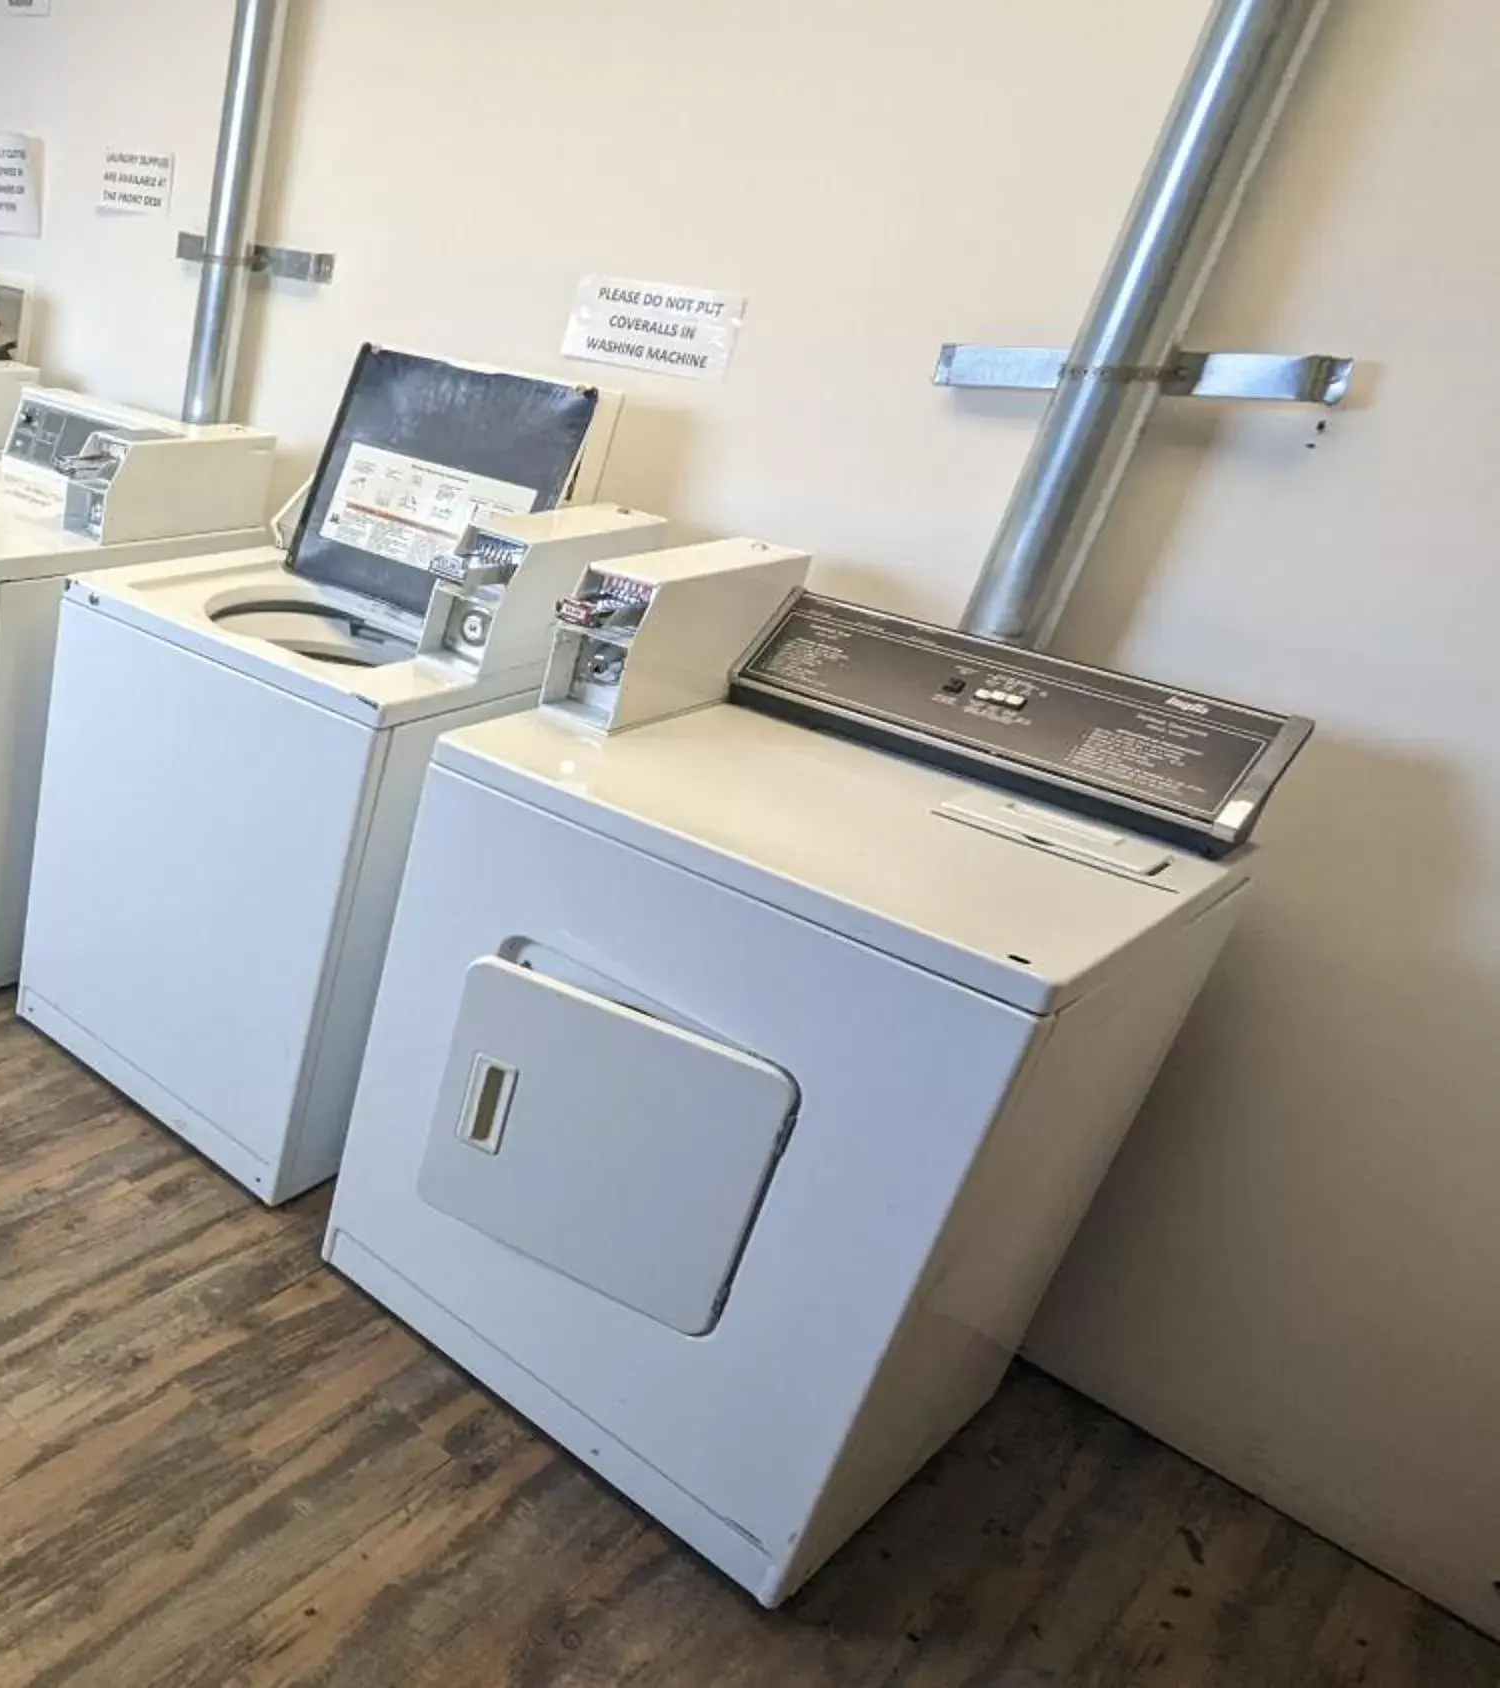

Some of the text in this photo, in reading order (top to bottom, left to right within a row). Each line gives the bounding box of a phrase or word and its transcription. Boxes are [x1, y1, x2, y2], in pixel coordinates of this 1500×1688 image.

[598, 287, 725, 317] PLEASE DO NOT PUT
[609, 315, 697, 340] COVERALLS IN
[586, 335, 708, 369] WASHING MACHINE
